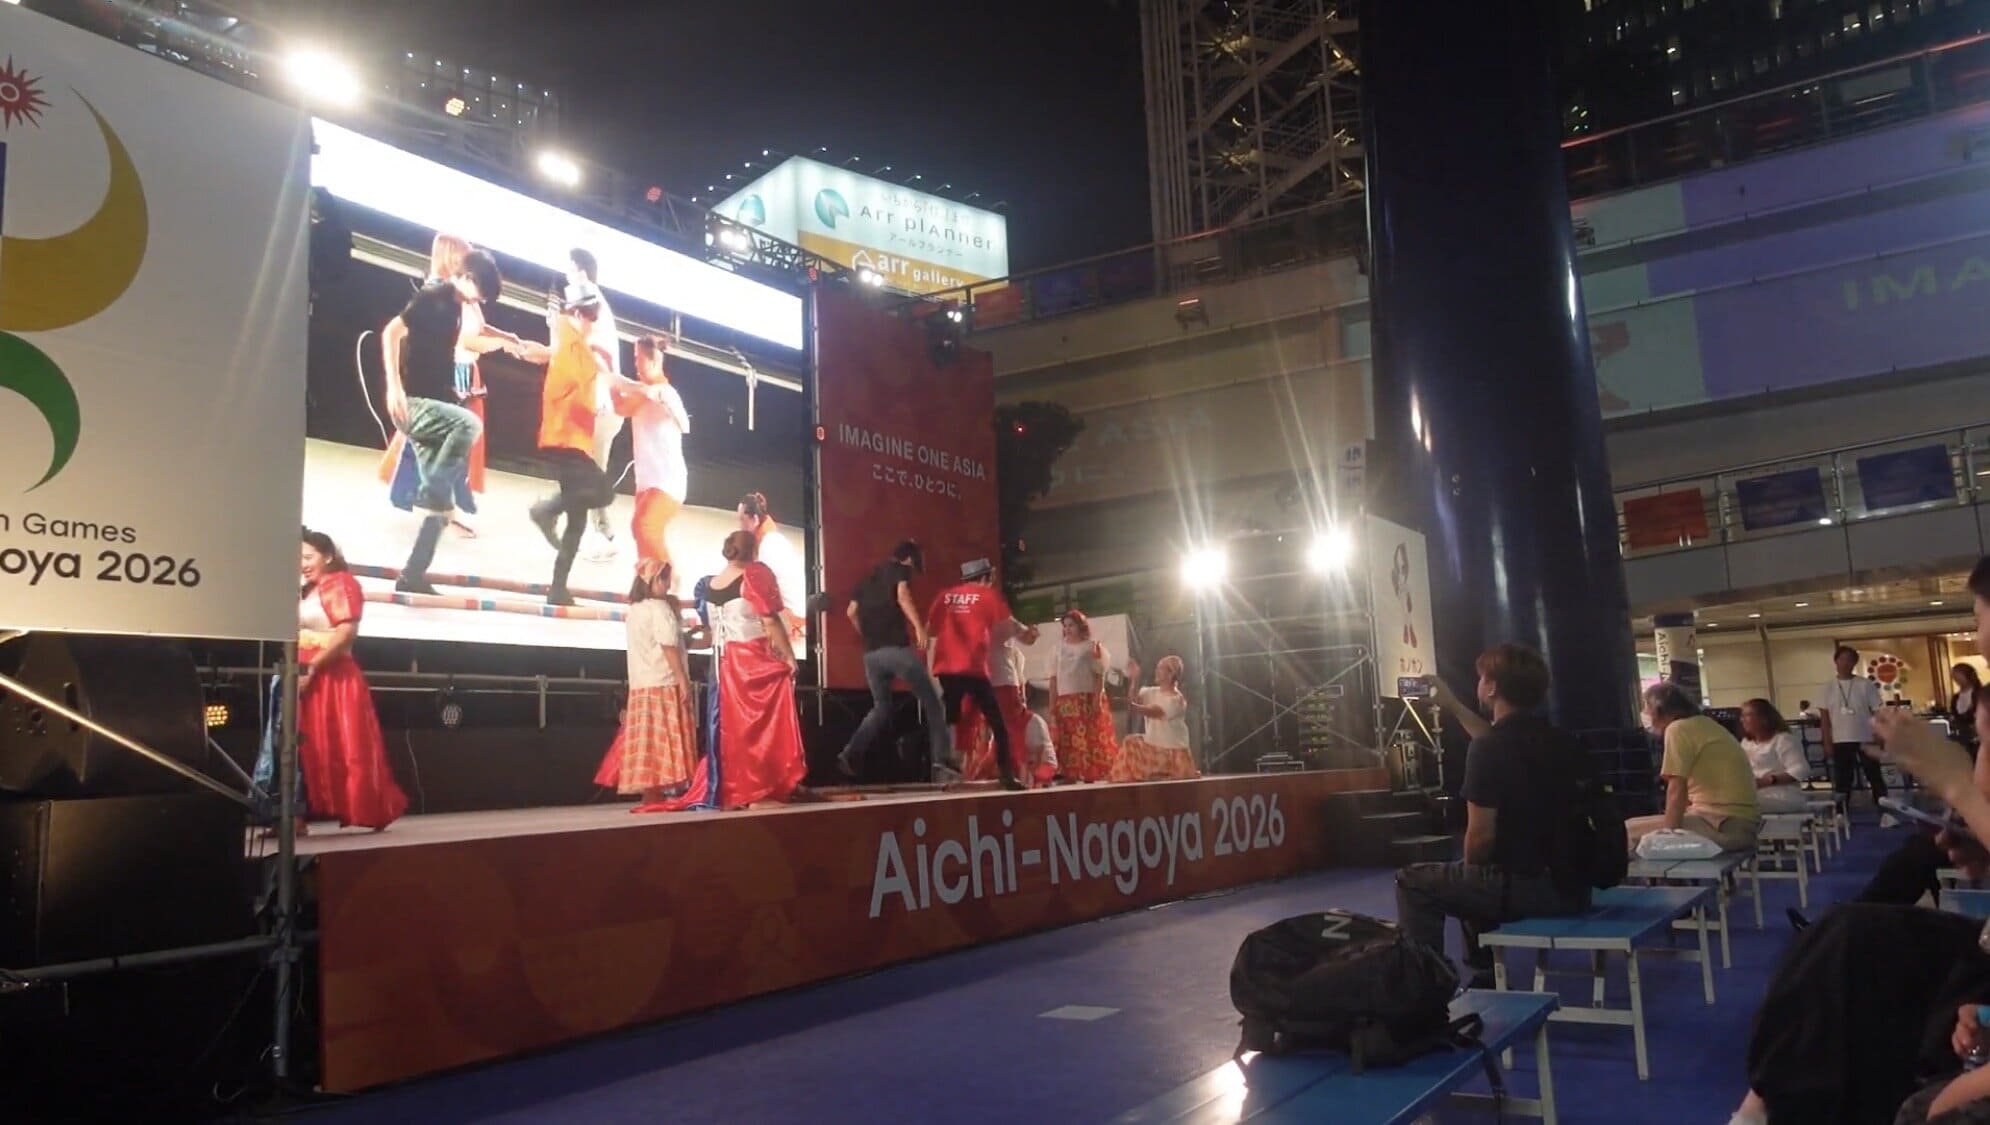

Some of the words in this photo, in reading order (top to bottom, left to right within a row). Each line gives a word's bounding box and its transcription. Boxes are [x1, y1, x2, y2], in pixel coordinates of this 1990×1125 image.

[860, 205, 895, 224] Arr
[878, 254, 910, 275] arr
[913, 268, 963, 288] gallery
[839, 423, 914, 461] IMAGINE
[918, 446, 950, 470] ONE
[953, 456, 985, 480] ASIA
[23, 512, 137, 544] Games
[97, 550, 201, 588] 2026
[944, 593, 980, 605] STAFF
[869, 809, 1203, 918] Aichi-Nagoya
[1211, 793, 1286, 856] 2026
